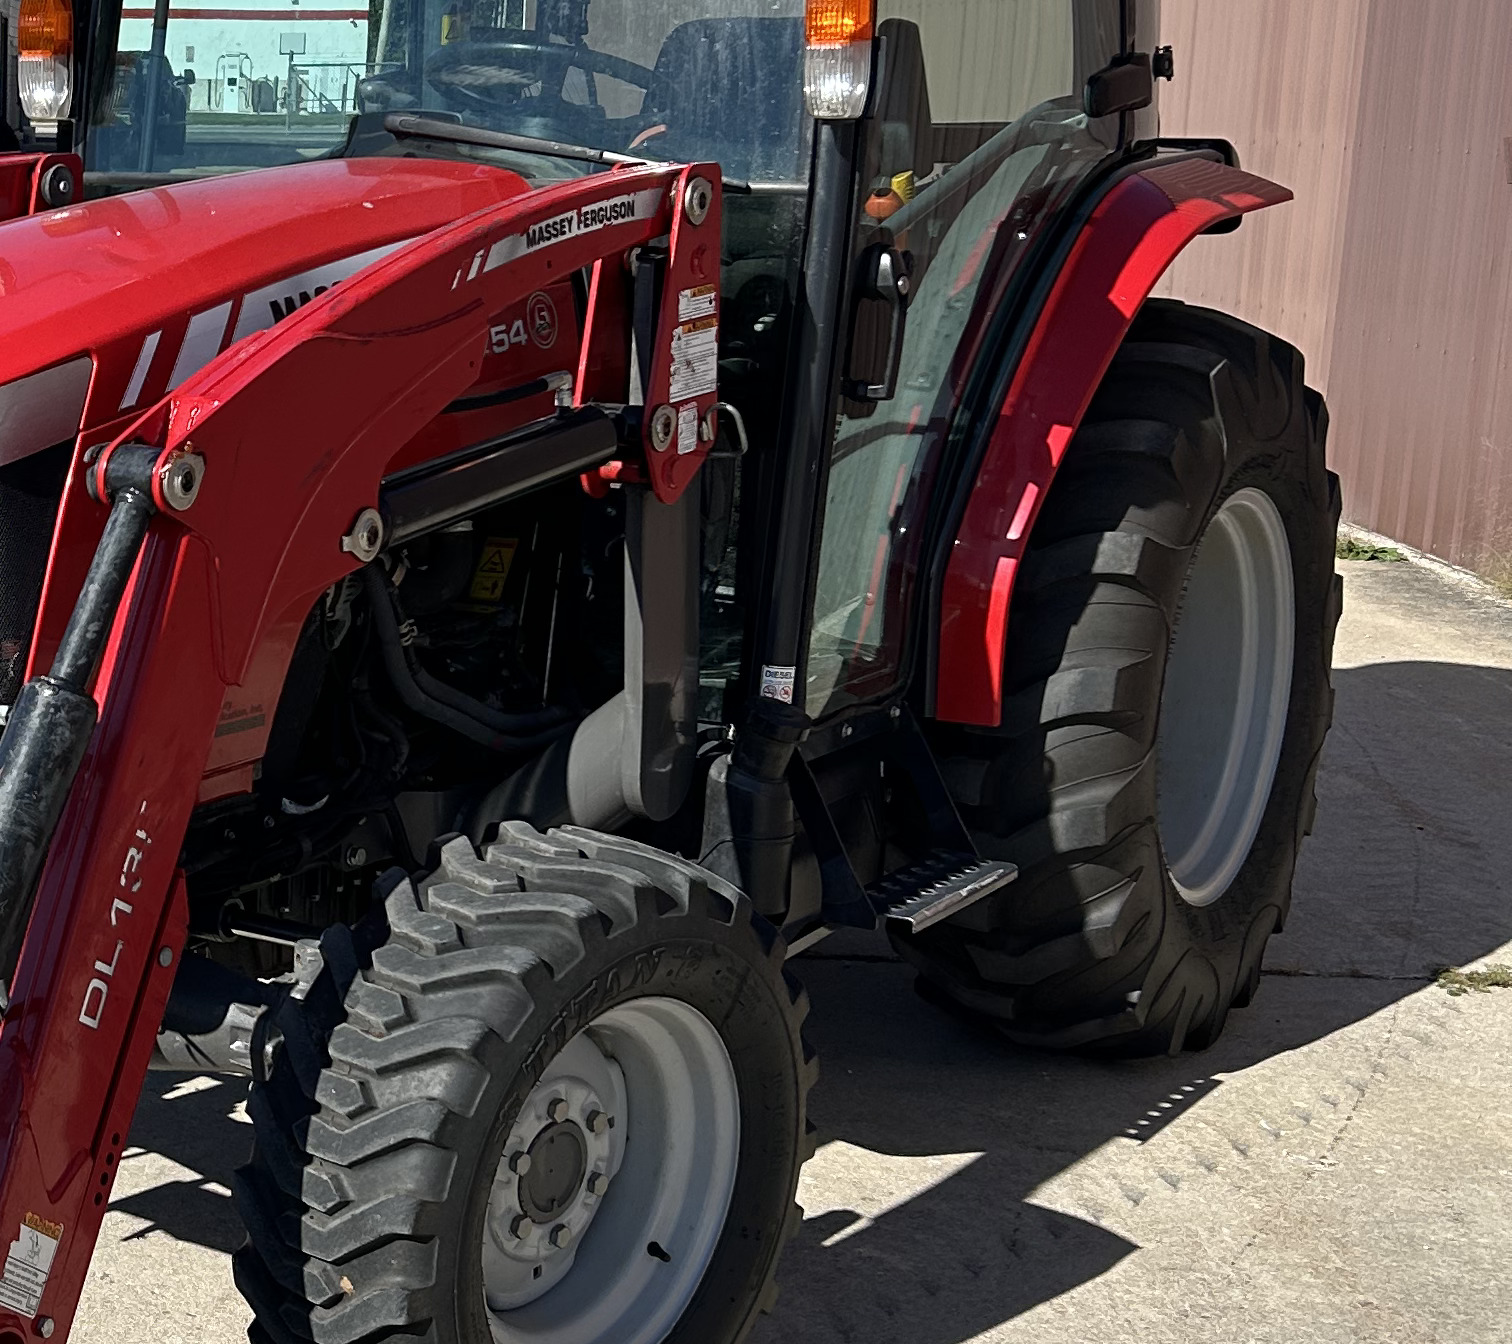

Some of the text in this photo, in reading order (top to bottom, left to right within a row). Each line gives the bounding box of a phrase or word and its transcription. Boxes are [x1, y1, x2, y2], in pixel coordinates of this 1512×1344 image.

[526, 200, 635, 249] MASSEY FERGUSON
[485, 319, 528, 354] 54
